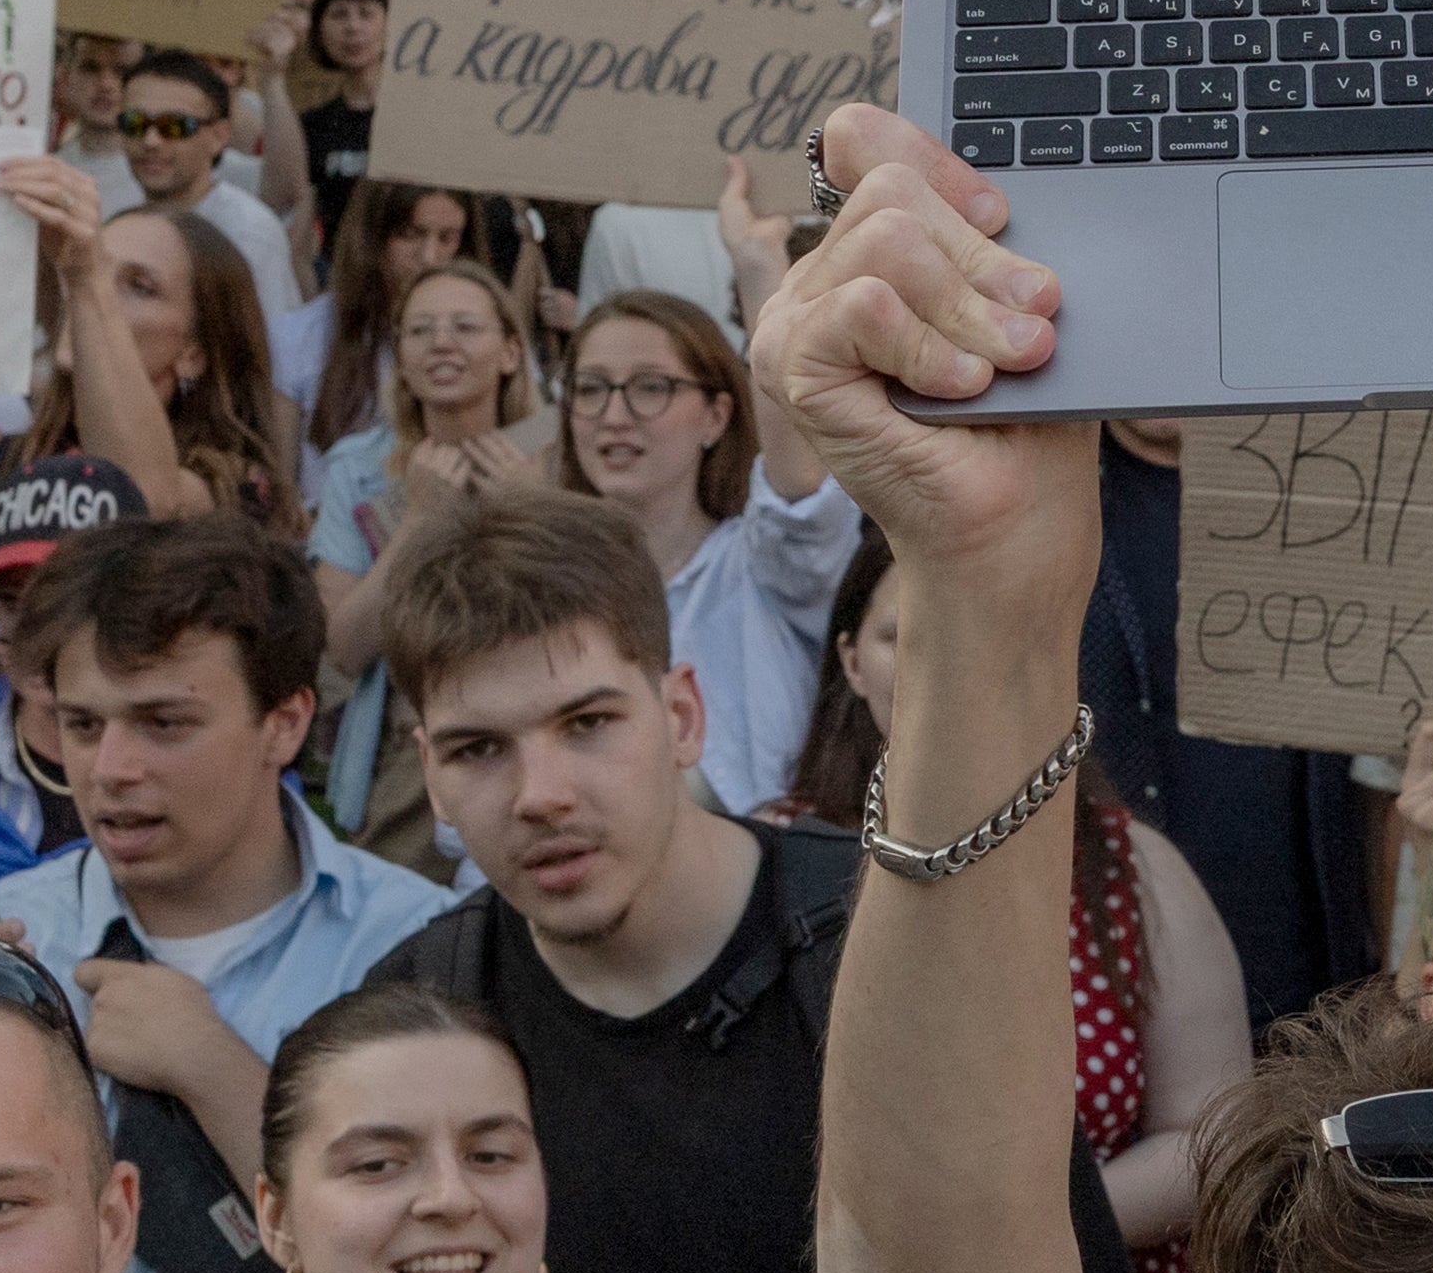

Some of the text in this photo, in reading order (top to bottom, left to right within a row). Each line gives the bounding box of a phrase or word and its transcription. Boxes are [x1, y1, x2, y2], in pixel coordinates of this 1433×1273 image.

[1166, 1, 1177, 11] Ц
[966, 9, 985, 17] tab
[1234, 34, 1246, 45] D
[1303, 32, 1312, 42] F
[1369, 30, 1381, 41] G
[1098, 39, 1110, 50] A
[1167, 36, 1177, 48] S
[1391, 40, 1400, 49] П
[1114, 50, 1126, 58] Ф
[454, 10, 720, 136] кадрова
[1269, 80, 1280, 91] C
[1337, 78, 1349, 89] V
[1407, 75, 1418, 86] B
[1133, 84, 1143, 96] Z
[1201, 82, 1212, 93] X
[1151, 94, 1160, 103] Я
[964, 101, 991, 109] shift
[1031, 146, 1073, 155] control
[1104, 144, 1142, 153] option
[1170, 141, 1228, 150] command
